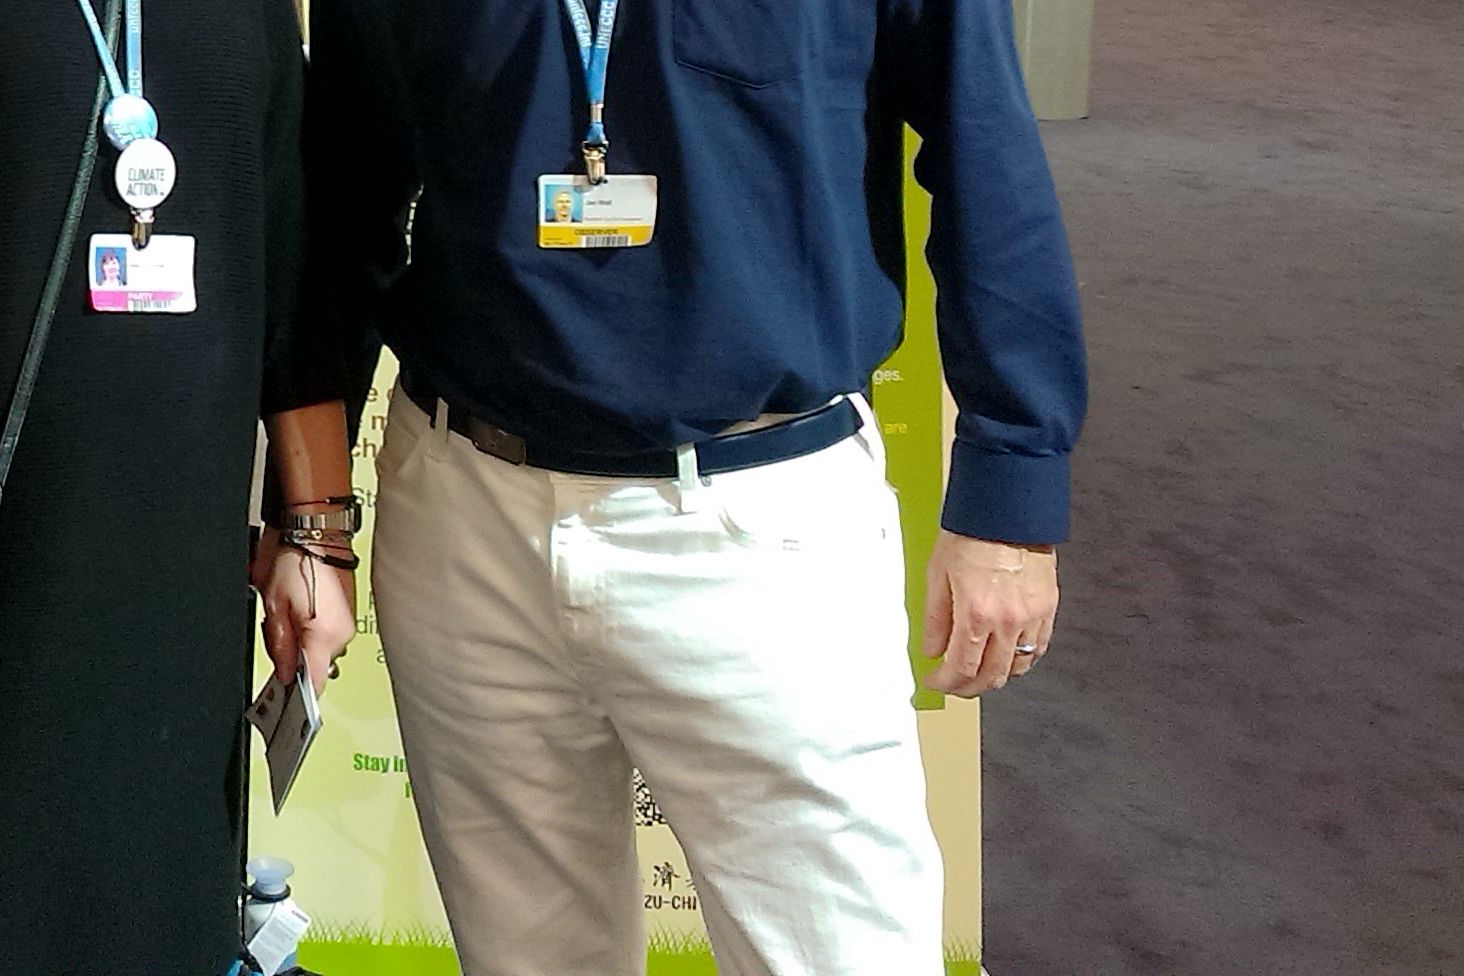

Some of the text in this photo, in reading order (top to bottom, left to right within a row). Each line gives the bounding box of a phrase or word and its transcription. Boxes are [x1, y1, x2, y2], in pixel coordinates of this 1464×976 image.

[127, 168, 166, 182] CLIMATE
[871, 369, 905, 385] ges.
[884, 422, 908, 435] are
[353, 752, 391, 774] Stay
